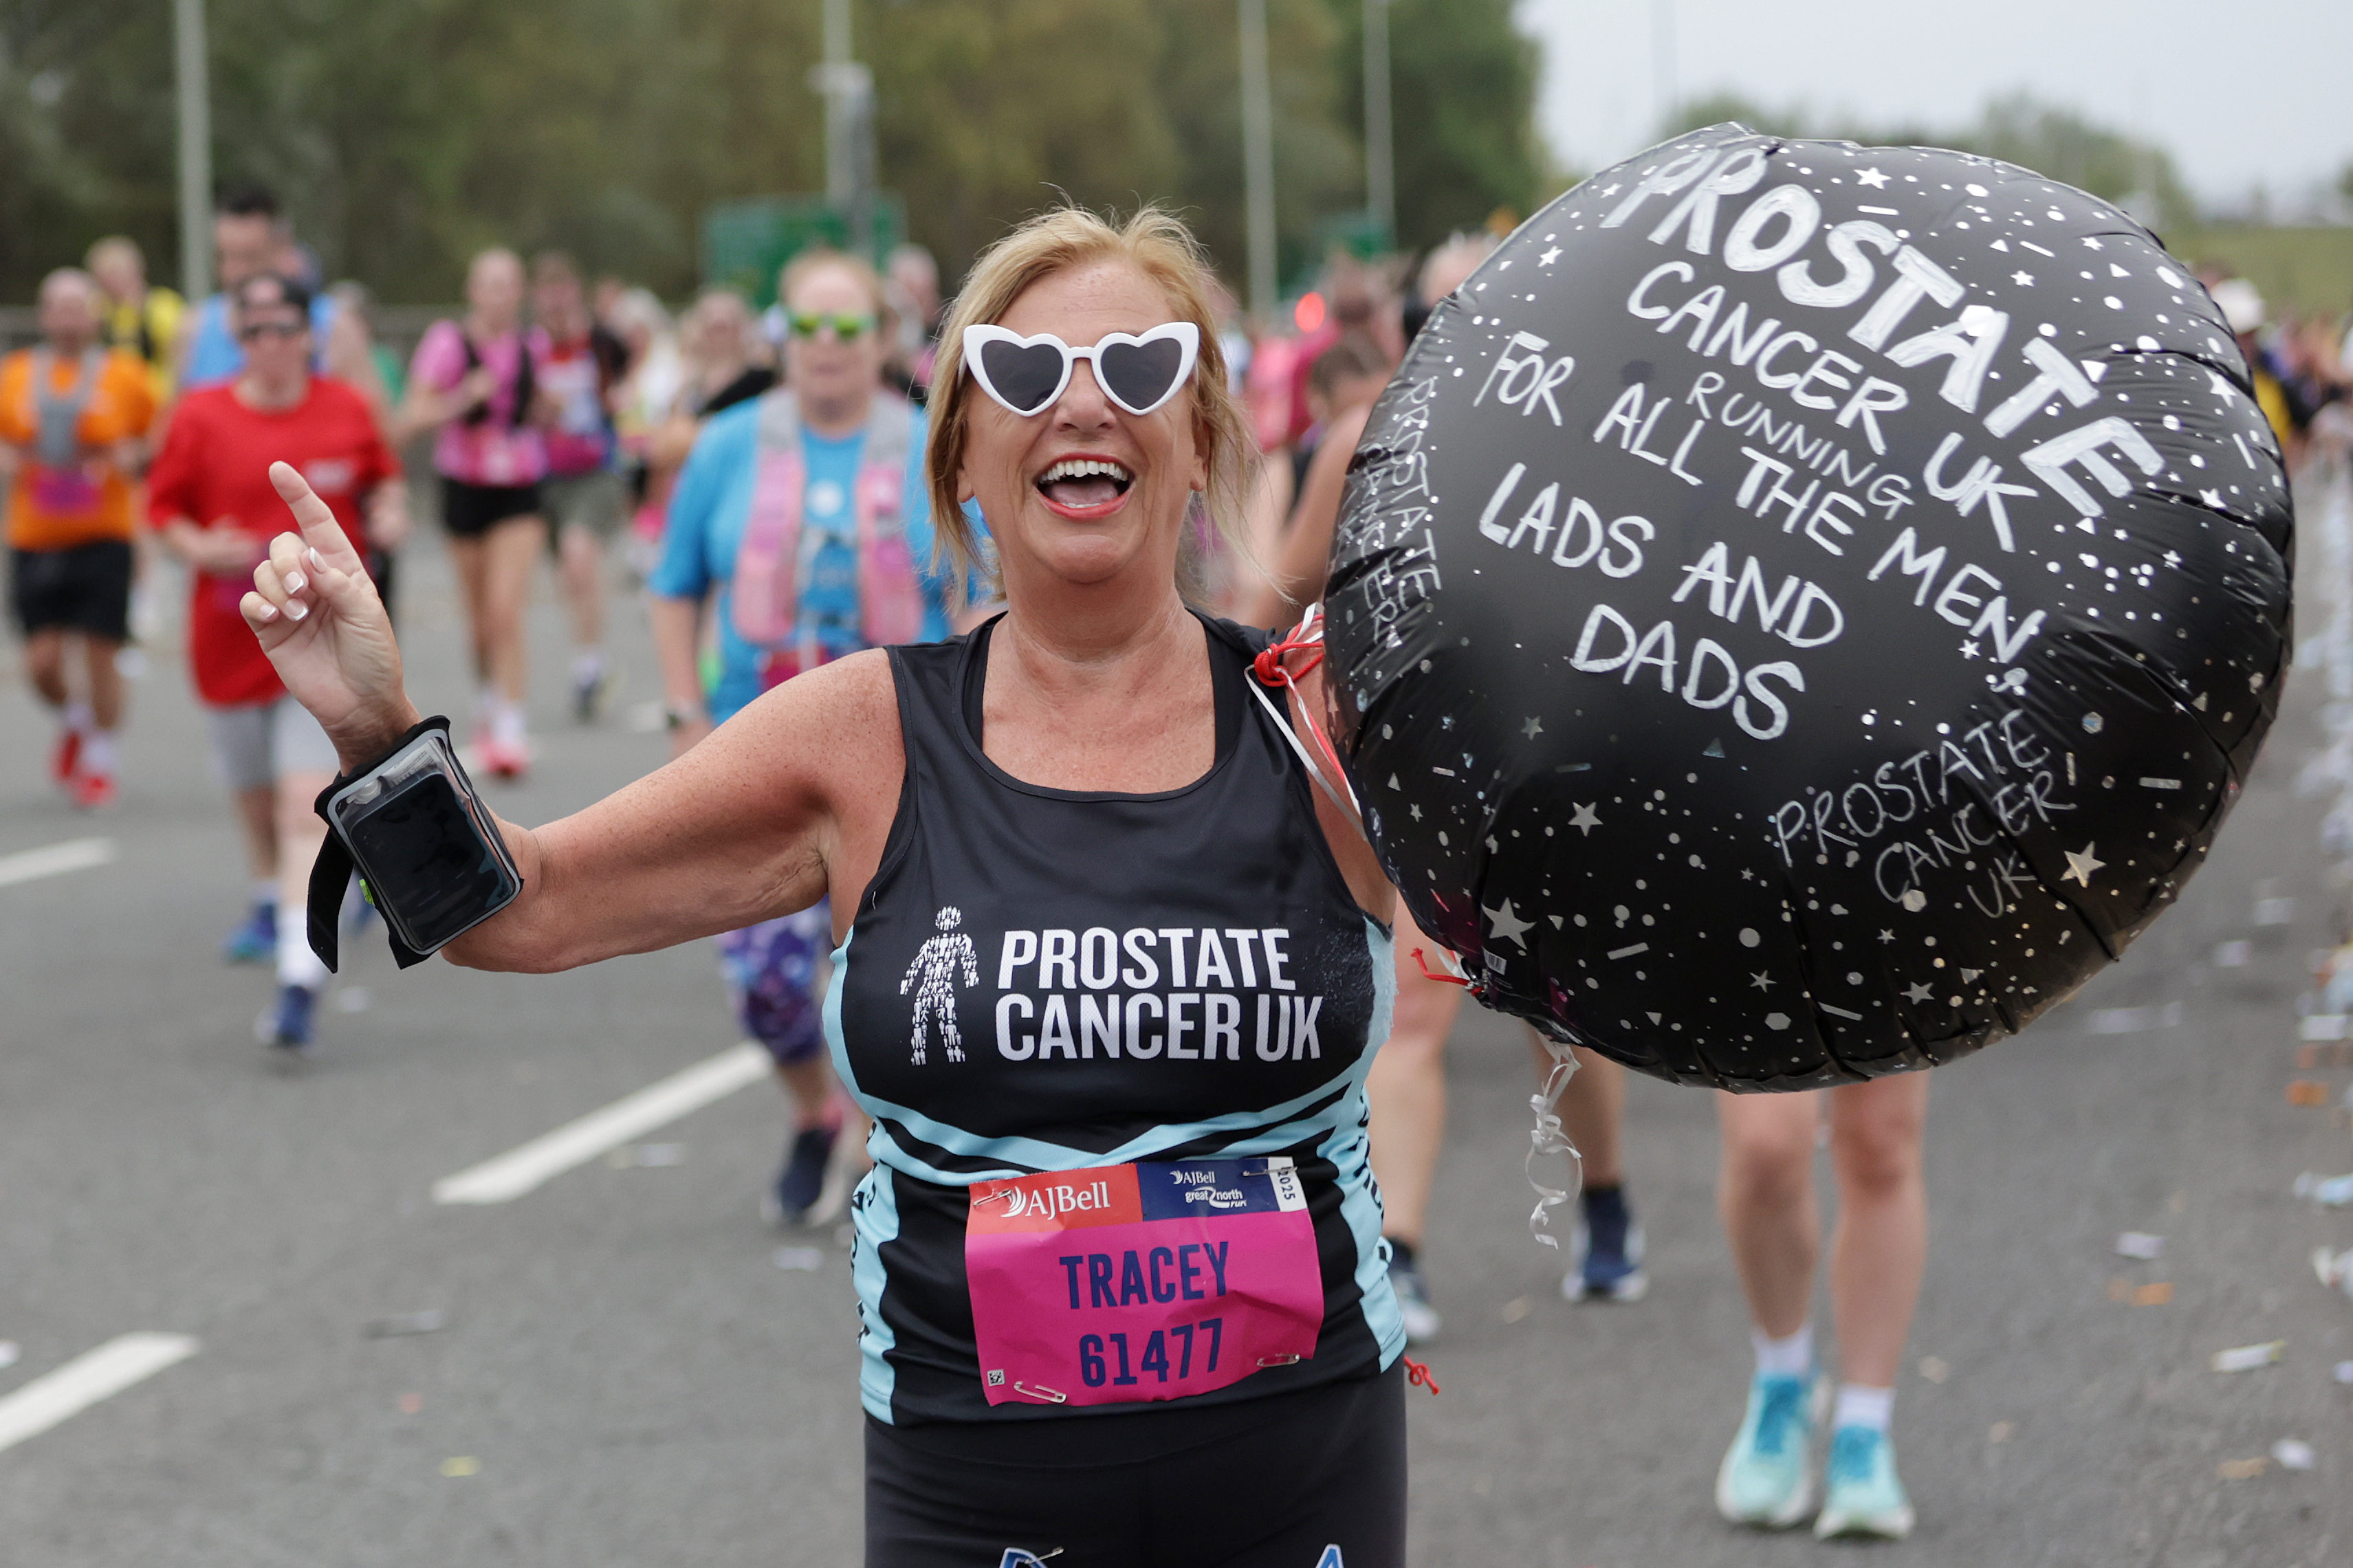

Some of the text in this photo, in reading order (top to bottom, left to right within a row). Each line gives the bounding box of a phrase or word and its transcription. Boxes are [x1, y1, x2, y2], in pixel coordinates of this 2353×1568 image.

[1599, 148, 2165, 517] PROSTATE
[1628, 261, 2039, 552] CANCER UK
[1686, 371, 1914, 520] RUNNING
[1473, 331, 2047, 663] FOR ALL THE MEN
[1479, 463, 1843, 648] LADS AND
[1570, 604, 1804, 740] DADS
[1775, 709, 2050, 868] PROSTATE
[1875, 771, 2077, 903] CANCER
[1967, 850, 2038, 918] UK
[998, 927, 1296, 991] PROSTATE
[996, 993, 1324, 1062] CANCER UK
[1185, 1188, 1243, 1203] great north
[1229, 1199, 1247, 1208] run
[1278, 1170, 1295, 1200] 2025
[1060, 1241, 1229, 1310] TRACEY
[1079, 1318, 1223, 1389] 61477
